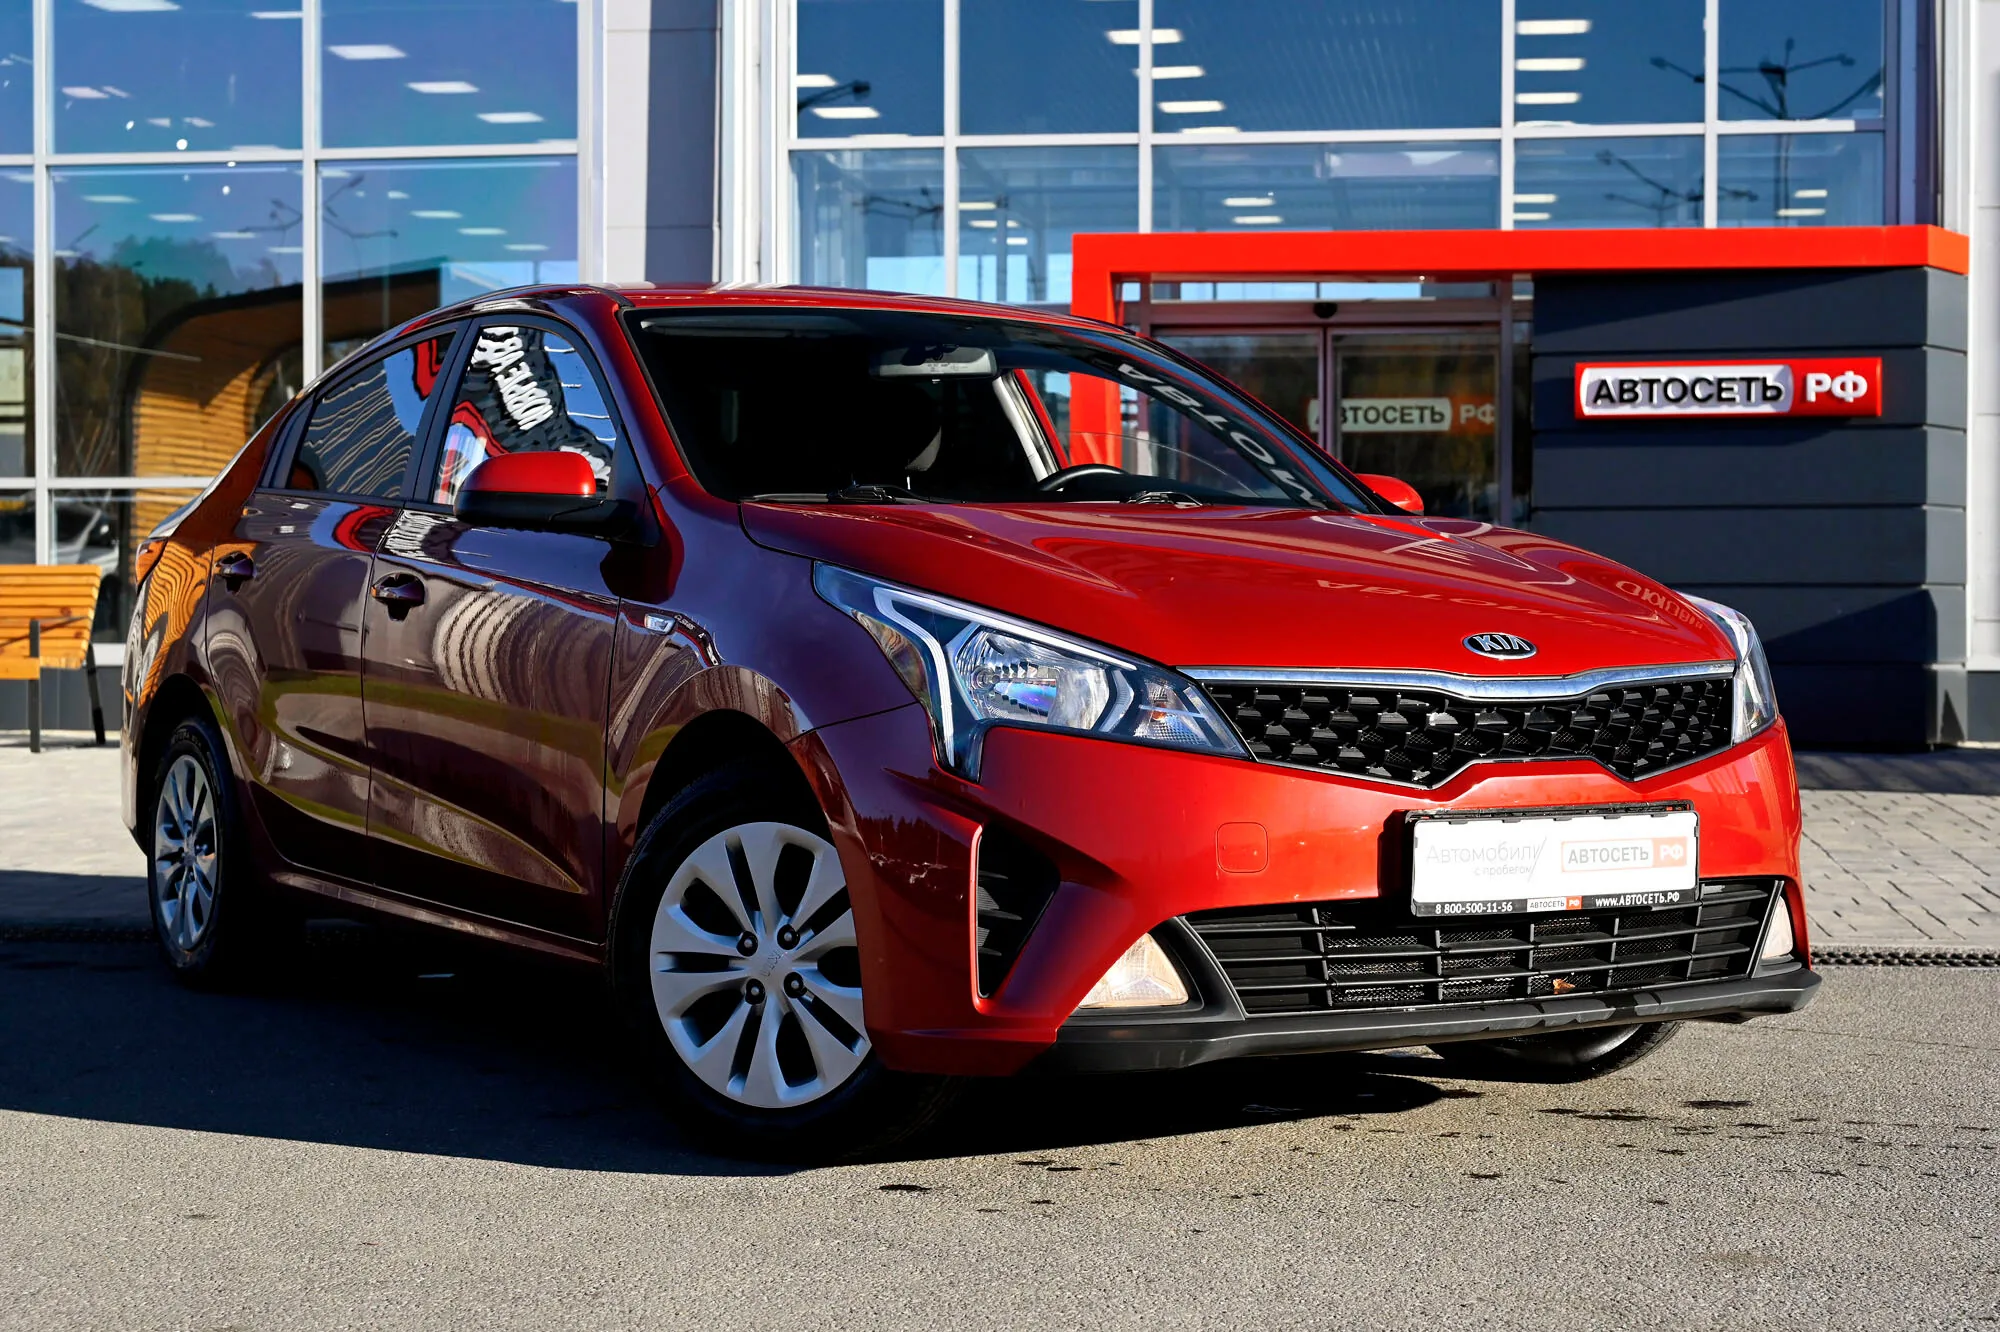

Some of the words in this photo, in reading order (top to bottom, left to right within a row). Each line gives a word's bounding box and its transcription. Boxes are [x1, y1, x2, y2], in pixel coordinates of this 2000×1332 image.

[1593, 376, 1785, 405] АВТОСЕТЬ
[1805, 370, 1868, 403] РФ
[1315, 404, 1446, 425] ВТОСЕТЬ
[1459, 403, 1496, 424] РФ
[1472, 634, 1531, 652] KIA
[1567, 846, 1649, 865] АВТОСЕТЬ
[1659, 844, 1684, 861] РФ
[1435, 904, 1442, 915] 8
[1444, 901, 1513, 914] 800-500-11-56
[1530, 900, 1565, 909] АВТОСЕТЬ
[1568, 898, 1580, 907] РФ
